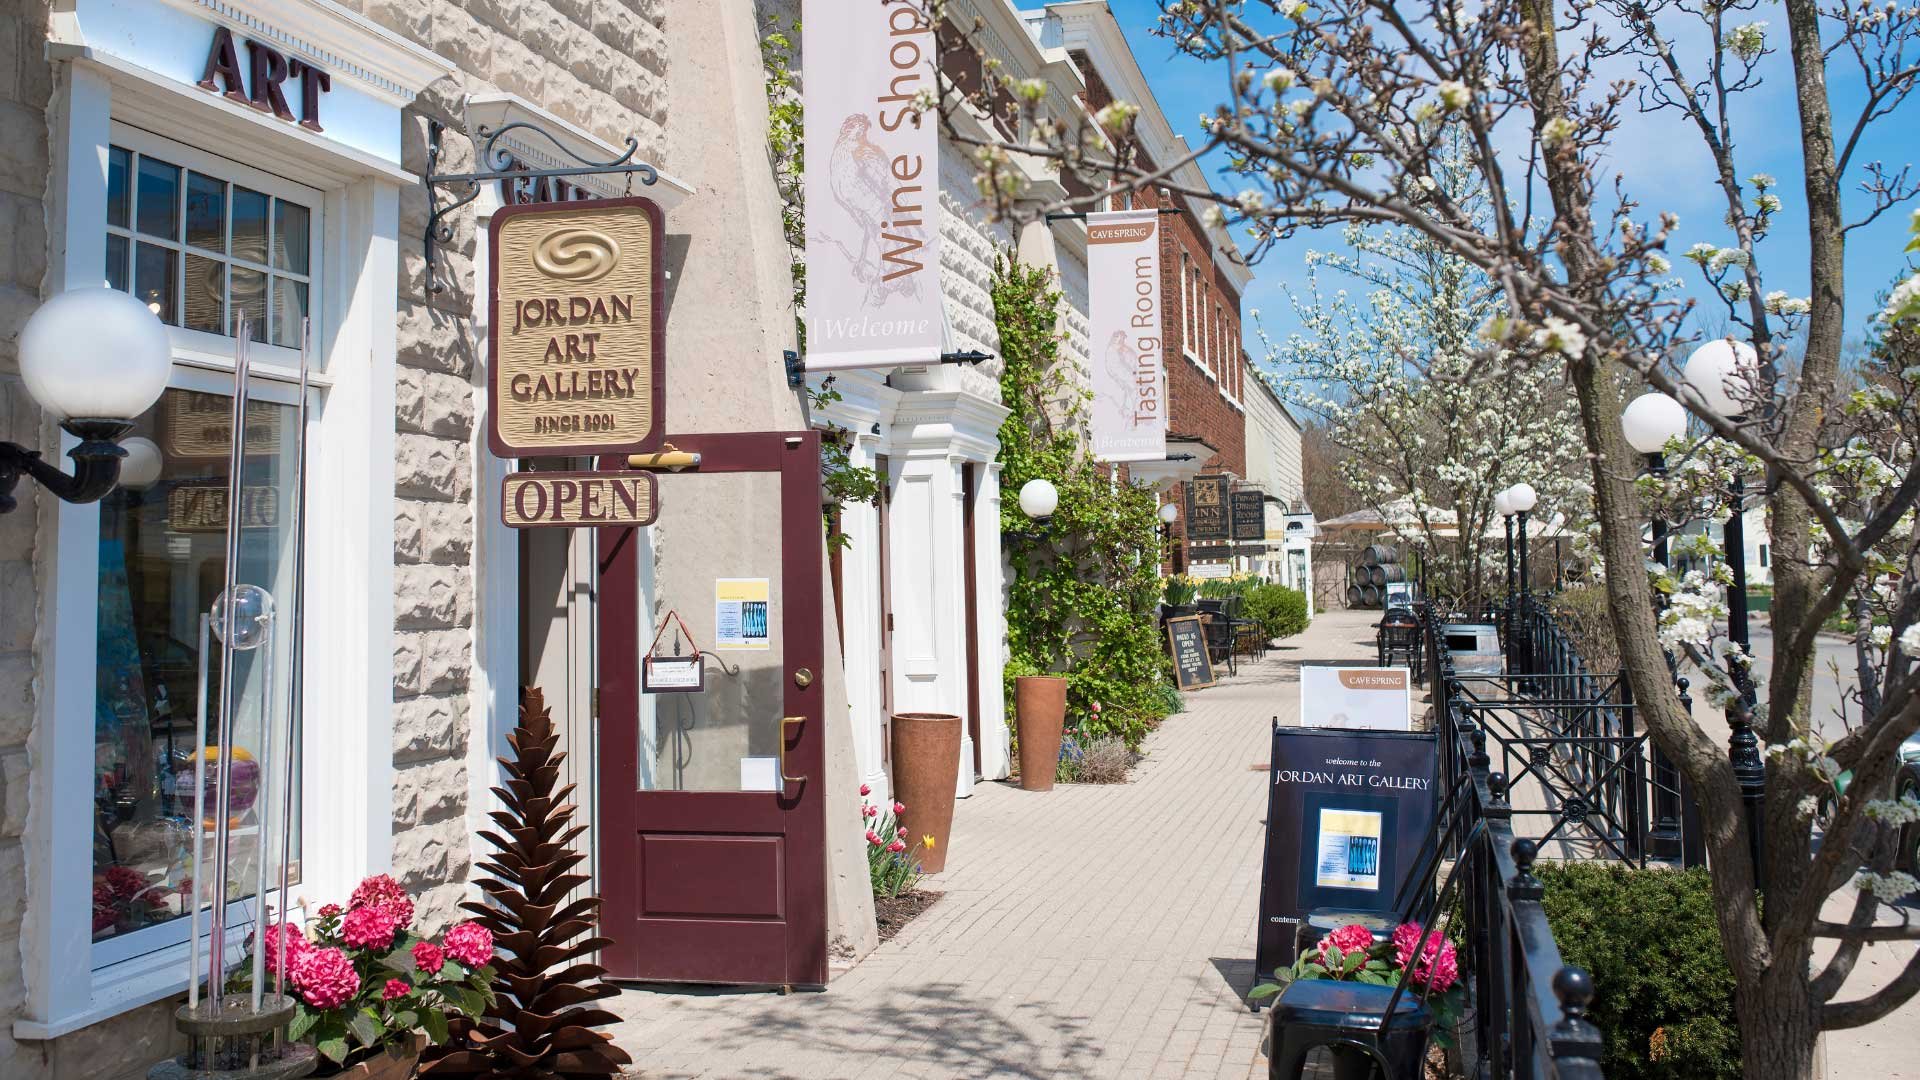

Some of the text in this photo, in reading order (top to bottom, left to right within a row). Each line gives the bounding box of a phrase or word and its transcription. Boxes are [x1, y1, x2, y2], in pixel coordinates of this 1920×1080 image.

[196, 26, 331, 133] ART
[878, 6, 931, 283] Wine Shop
[1090, 227, 1147, 239] CAVE SPRING
[512, 294, 634, 335] JORDAN
[825, 316, 929, 341] Welcome
[544, 332, 601, 364] ART
[1131, 255, 1161, 427] Tasting Room
[510, 368, 640, 403] GALLERY
[534, 413, 616, 434] SINCE 2001
[514, 479, 641, 522] OPEN
[1195, 507, 1220, 519] INN
[1349, 676, 1401, 685] CAVE SPRING
[1325, 757, 1382, 767] welcome to the
[1275, 770, 1430, 791] JORDAN ART GALLERY
